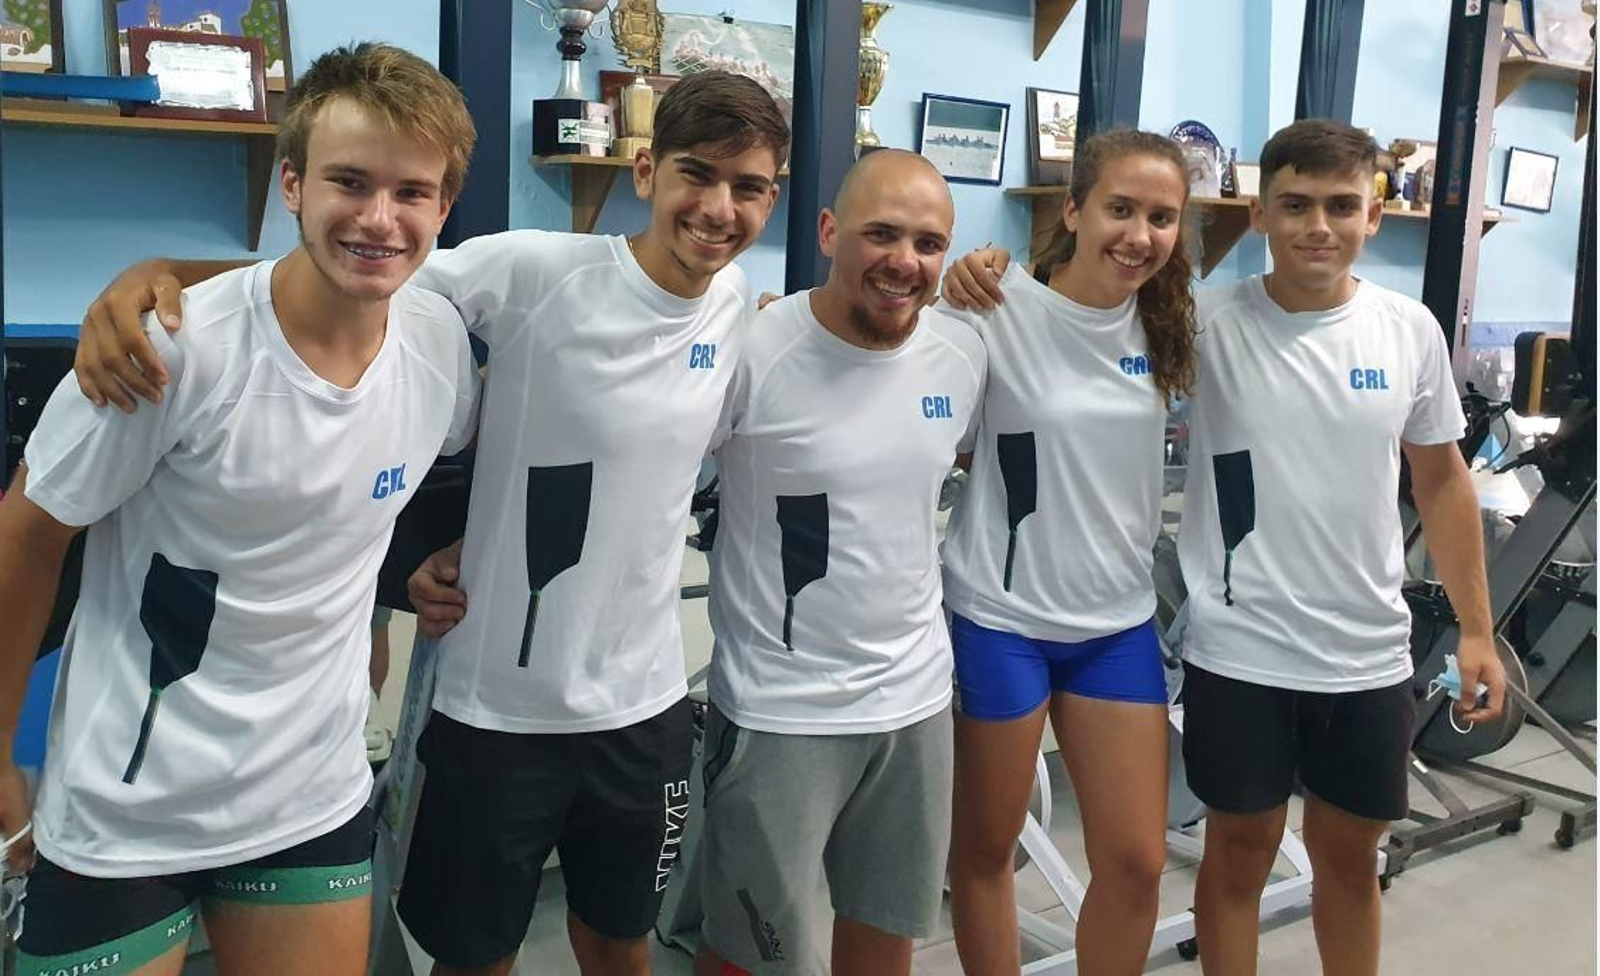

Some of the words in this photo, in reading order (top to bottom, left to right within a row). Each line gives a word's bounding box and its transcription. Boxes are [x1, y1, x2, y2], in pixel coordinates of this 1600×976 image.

[689, 343, 716, 369] CRL
[1350, 368, 1389, 390] CRL
[921, 396, 953, 418] CRL
